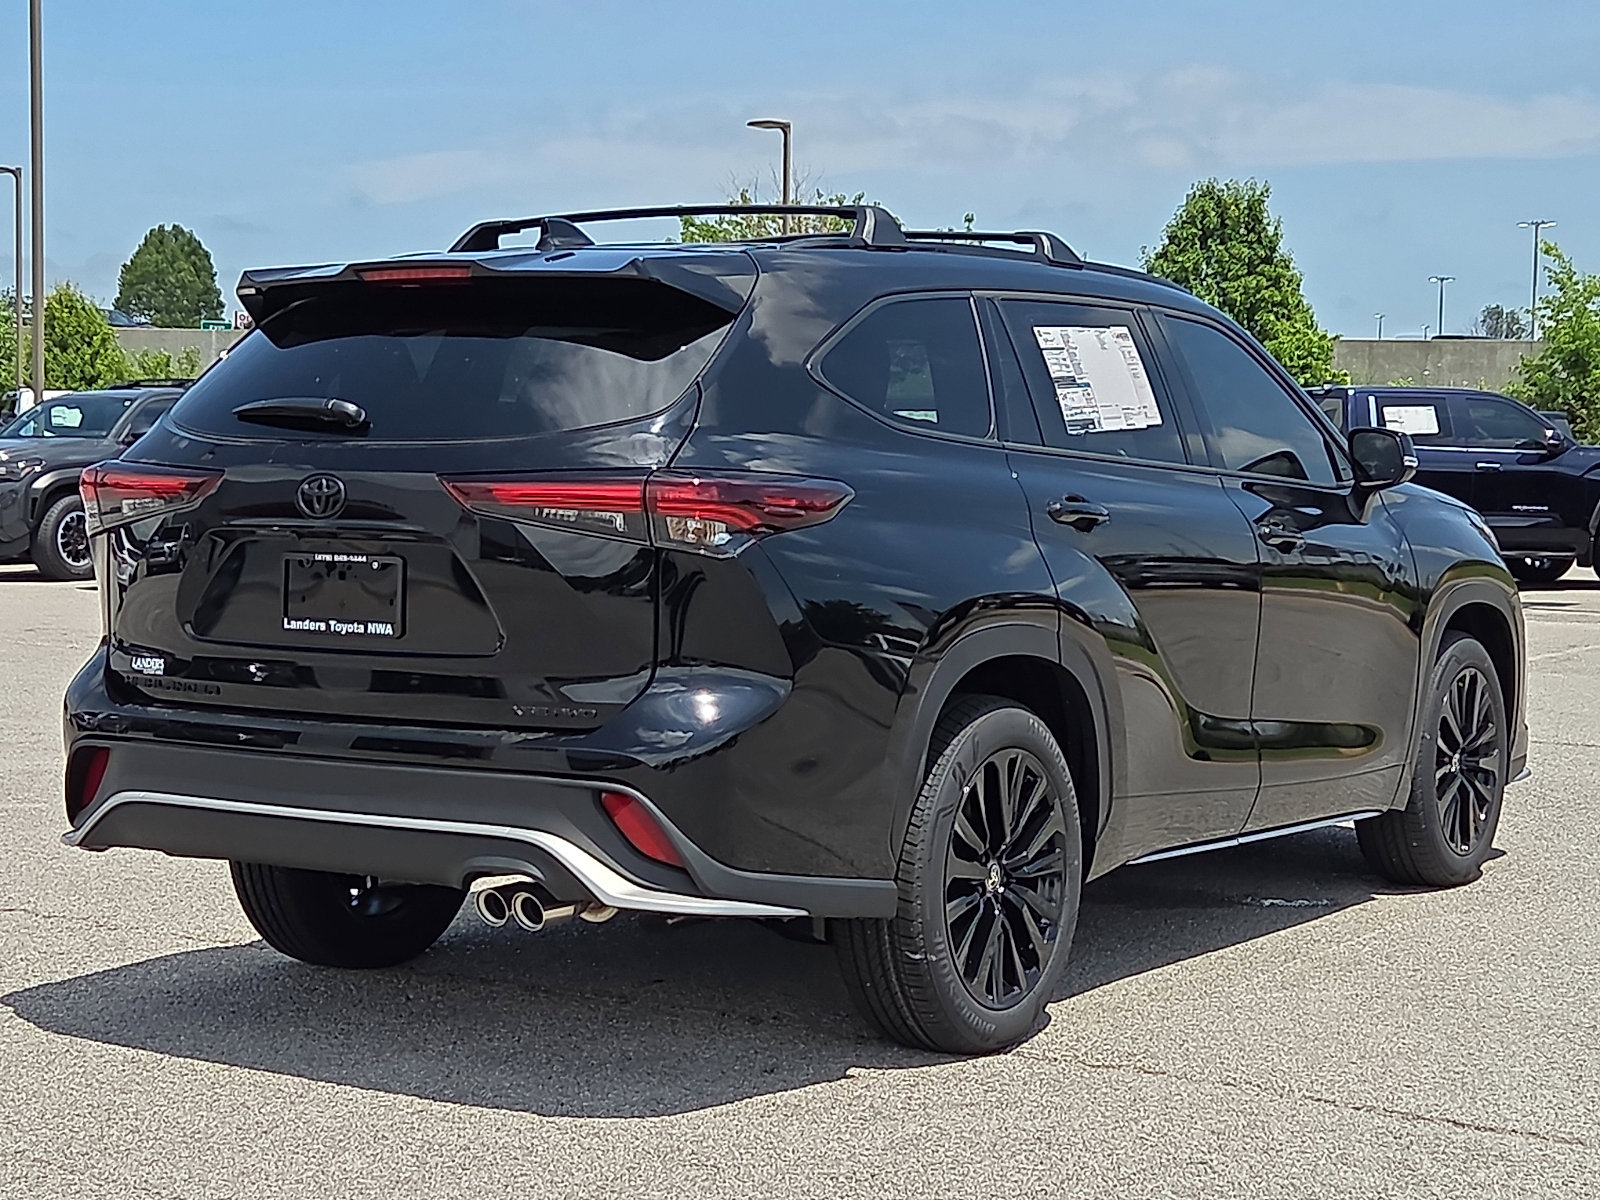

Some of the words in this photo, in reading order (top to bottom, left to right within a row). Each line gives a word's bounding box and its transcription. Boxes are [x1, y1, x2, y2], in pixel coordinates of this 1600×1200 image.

[283, 617, 327, 631] Landers
[329, 619, 365, 635] Toyota
[367, 622, 394, 635] NWA
[132, 656, 165, 669] LANDERS
